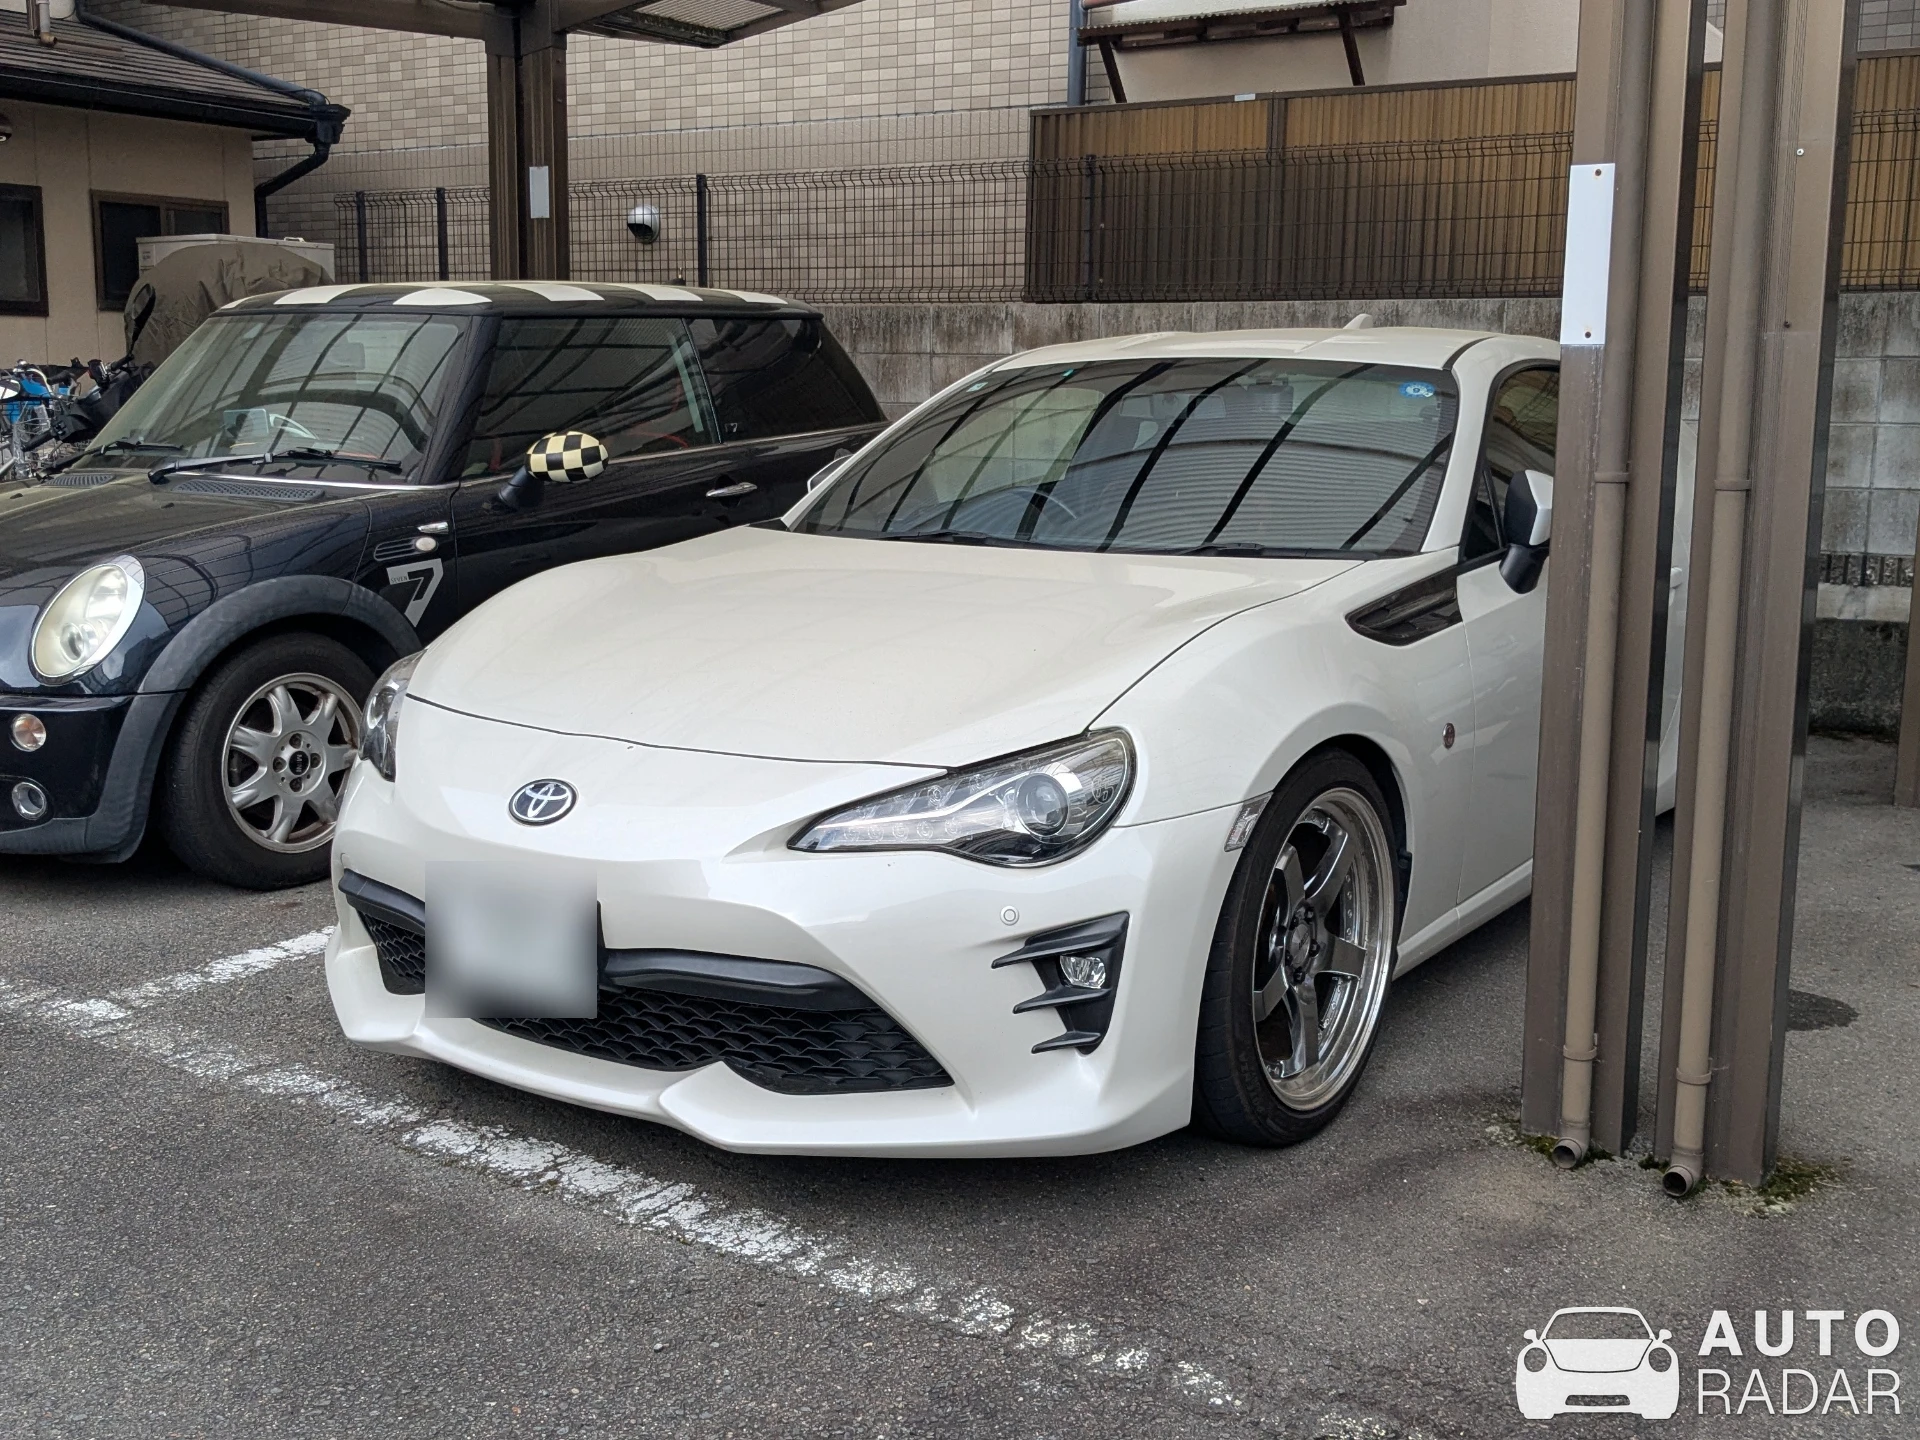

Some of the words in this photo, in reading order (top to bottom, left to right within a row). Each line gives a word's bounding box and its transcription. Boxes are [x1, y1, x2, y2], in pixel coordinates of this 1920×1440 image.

[390, 576, 408, 584] SEVEN
[386, 558, 444, 628] 7
[296, 754, 304, 773] MINI
